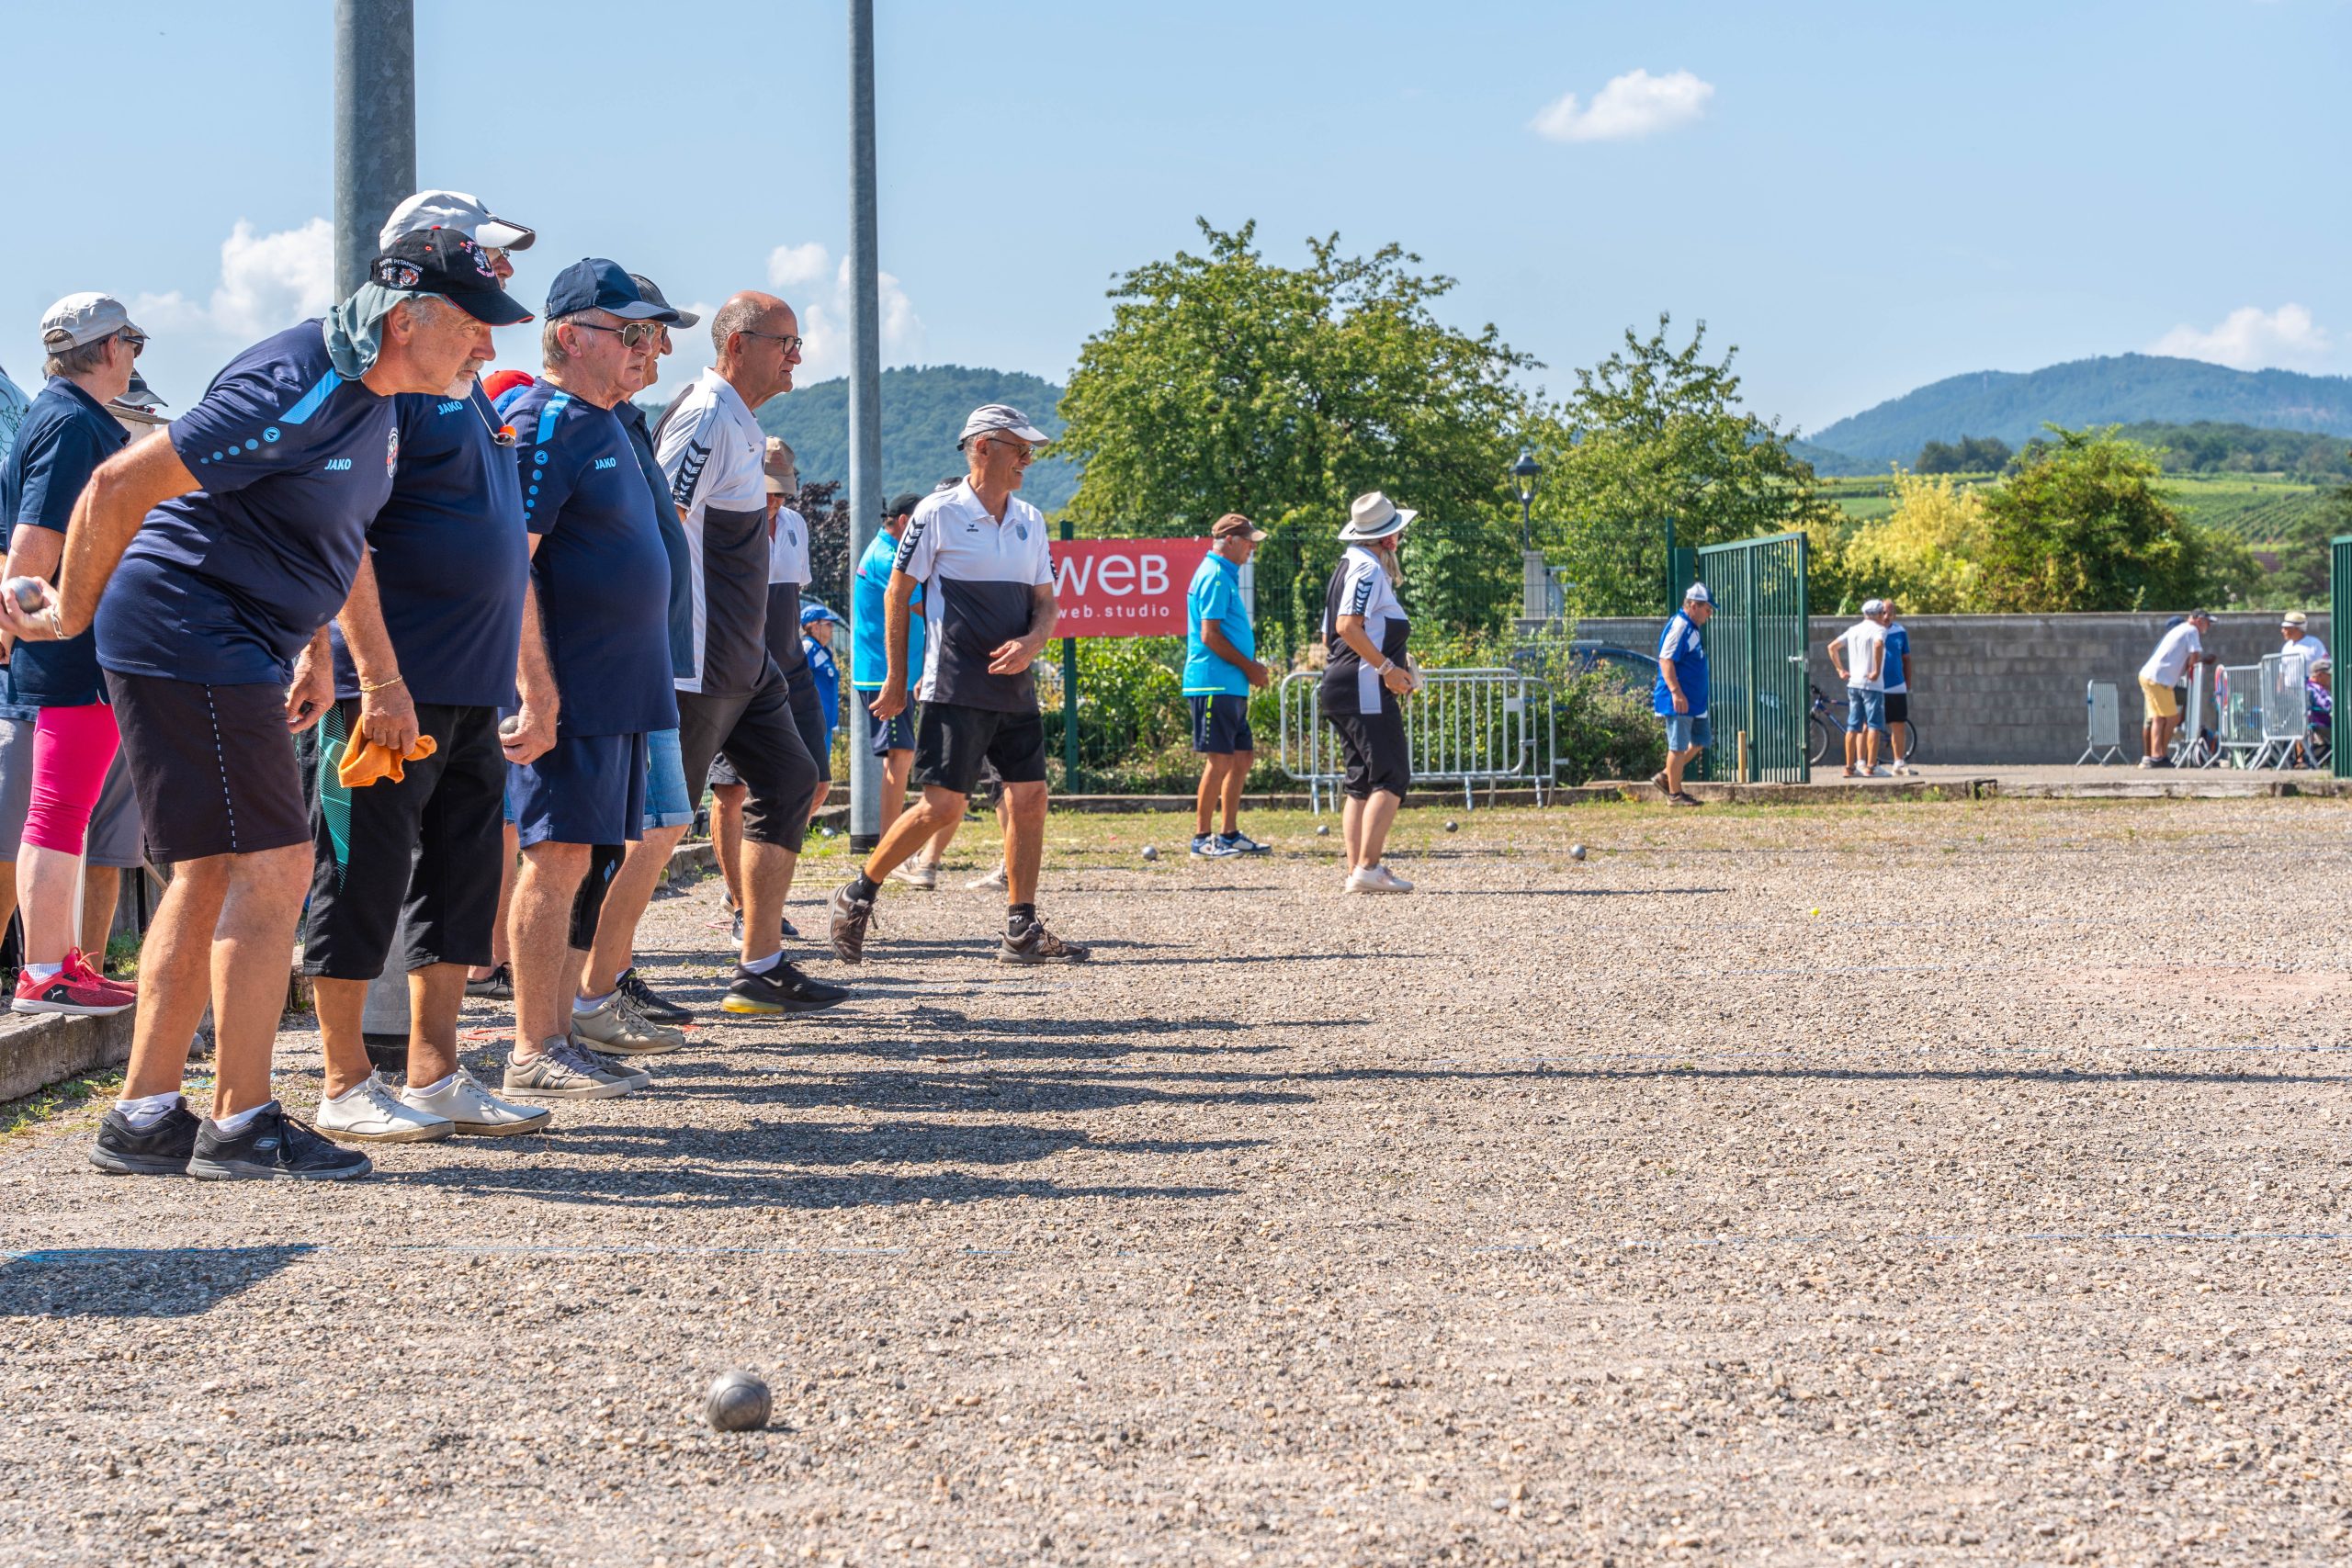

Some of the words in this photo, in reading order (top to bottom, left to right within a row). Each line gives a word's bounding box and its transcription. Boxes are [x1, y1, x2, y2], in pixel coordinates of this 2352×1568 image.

[393, 258, 424, 273] PETANQUE
[437, 400, 464, 415] JAKO
[324, 458, 352, 470] JAKO
[594, 457, 616, 470] JAKO
[1057, 604, 1170, 619] web.studio
